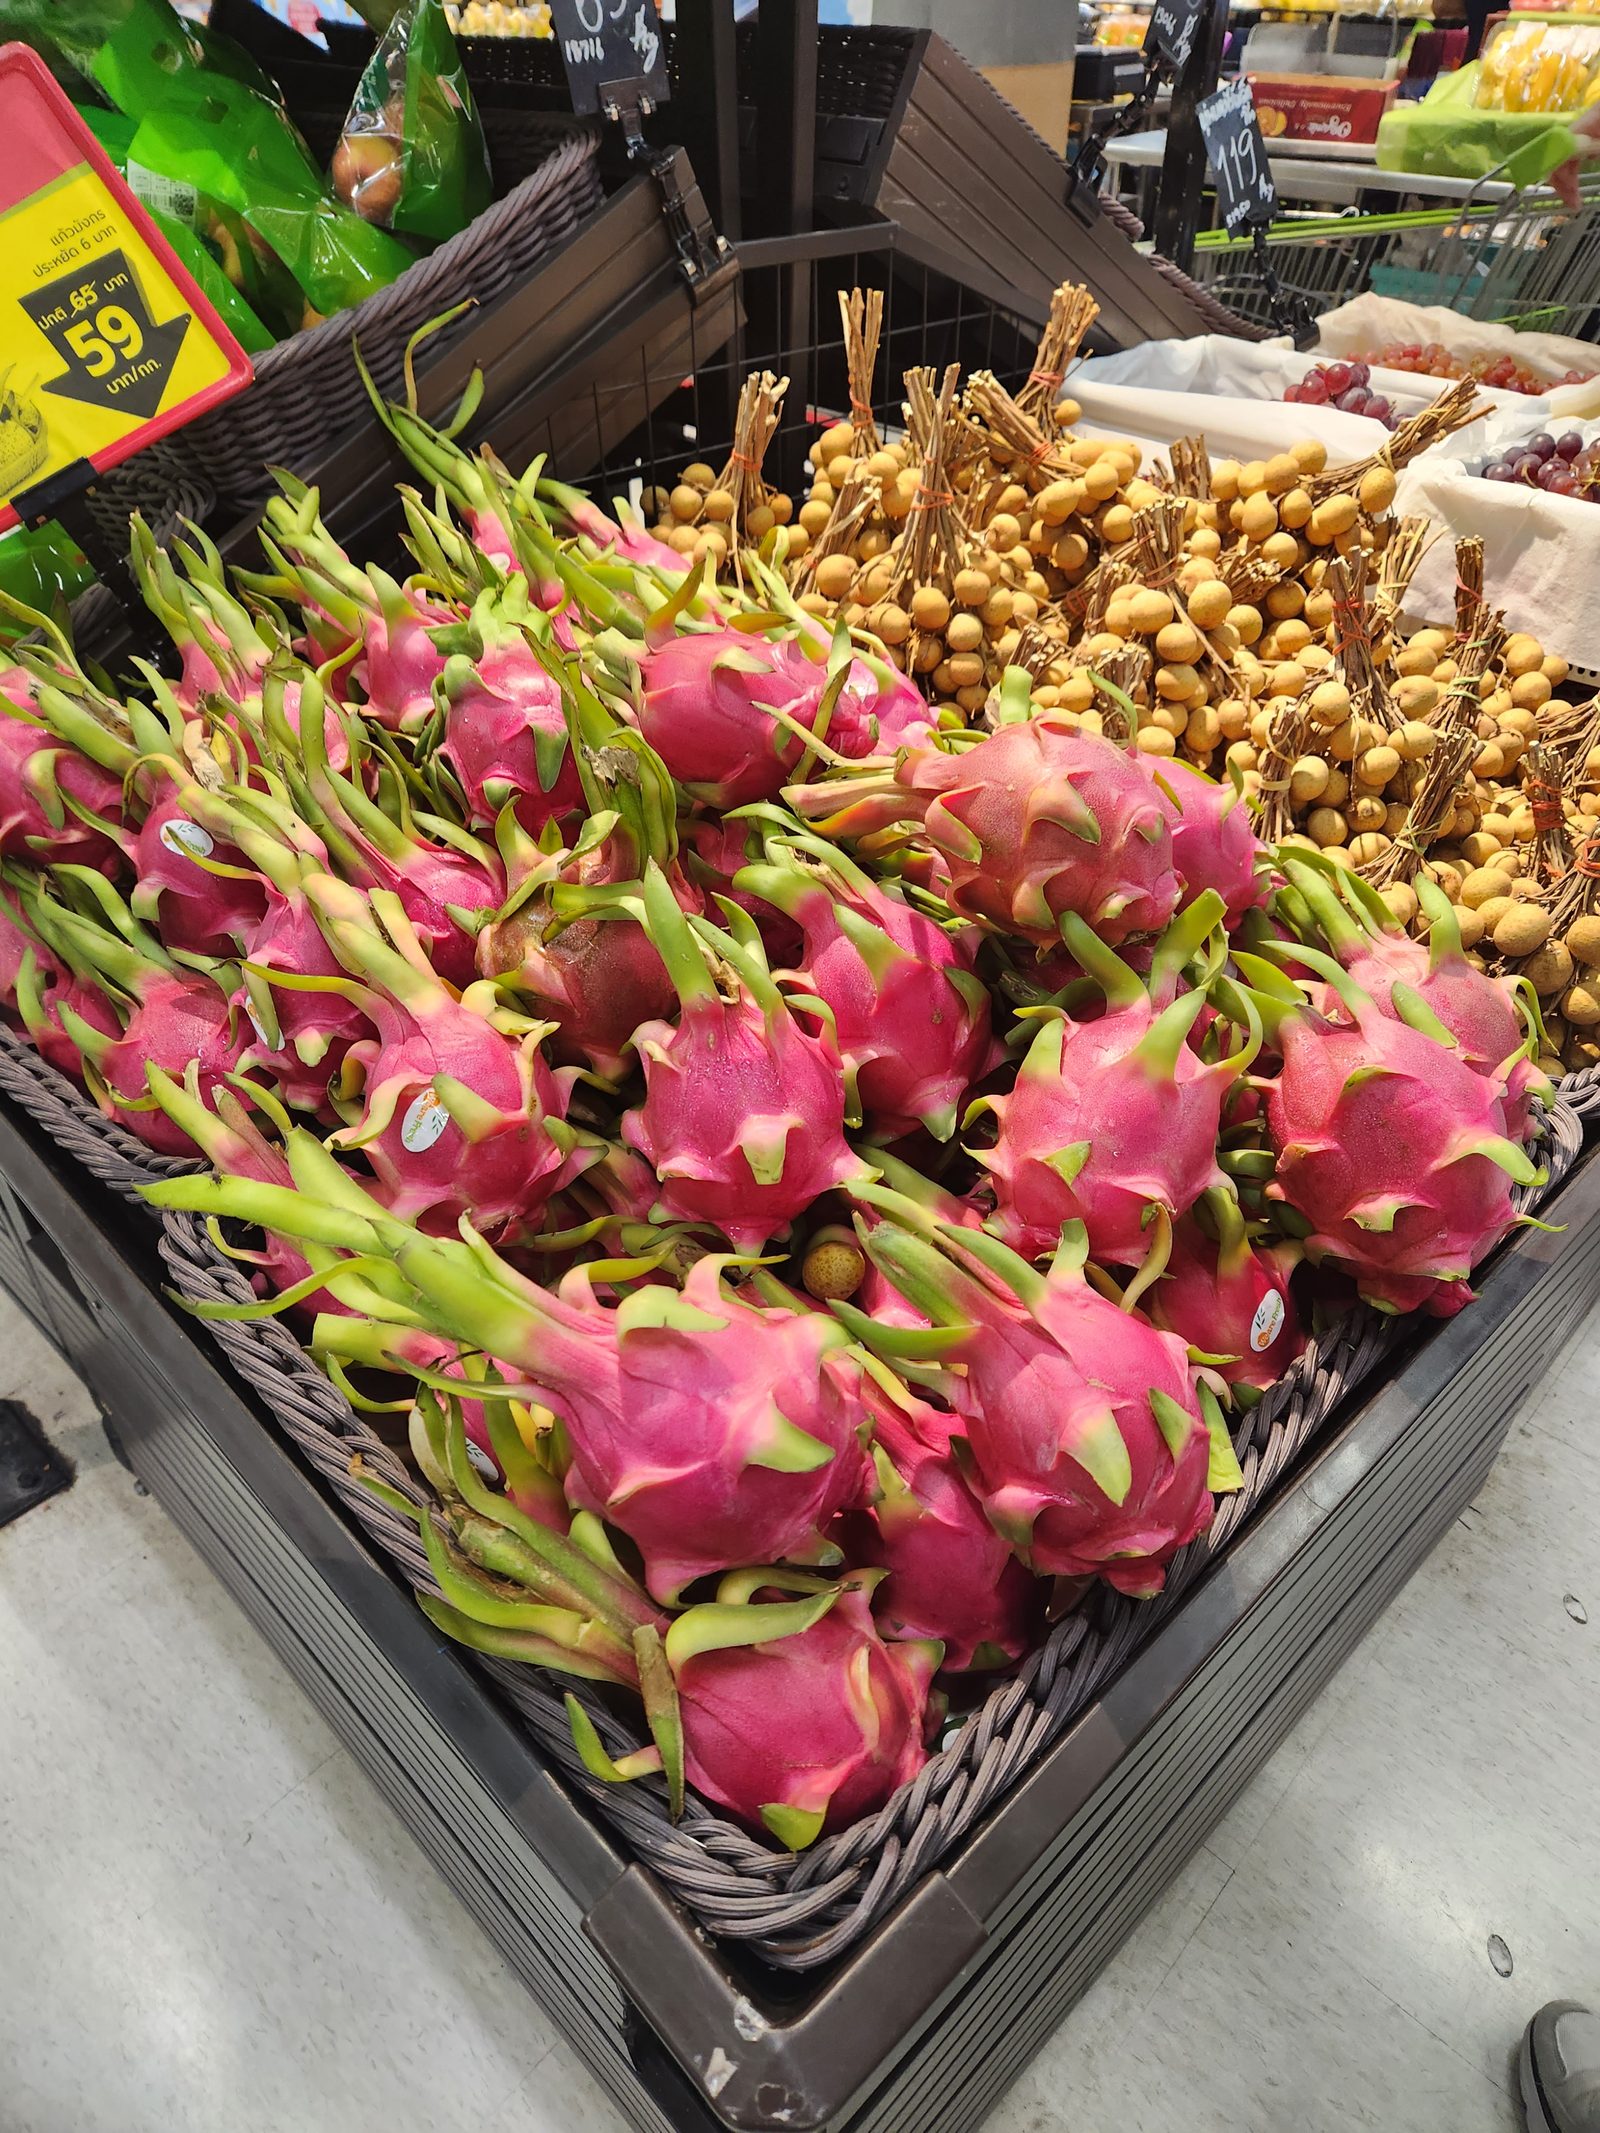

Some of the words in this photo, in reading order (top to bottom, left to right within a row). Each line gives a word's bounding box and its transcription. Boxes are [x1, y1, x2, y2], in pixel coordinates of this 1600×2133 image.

[1217, 128, 1257, 203] 119
[33, 247, 80, 277] ประหยัด
[80, 237, 91, 250] 6
[93, 225, 117, 243] บาท
[51, 209, 106, 246] แก้วมังกร
[38, 306, 68, 330] ปกติ
[69, 282, 98, 313] 65
[103, 272, 129, 292] บาท
[63, 305, 143, 378] 59
[106, 359, 162, 395] บาท/กก.
